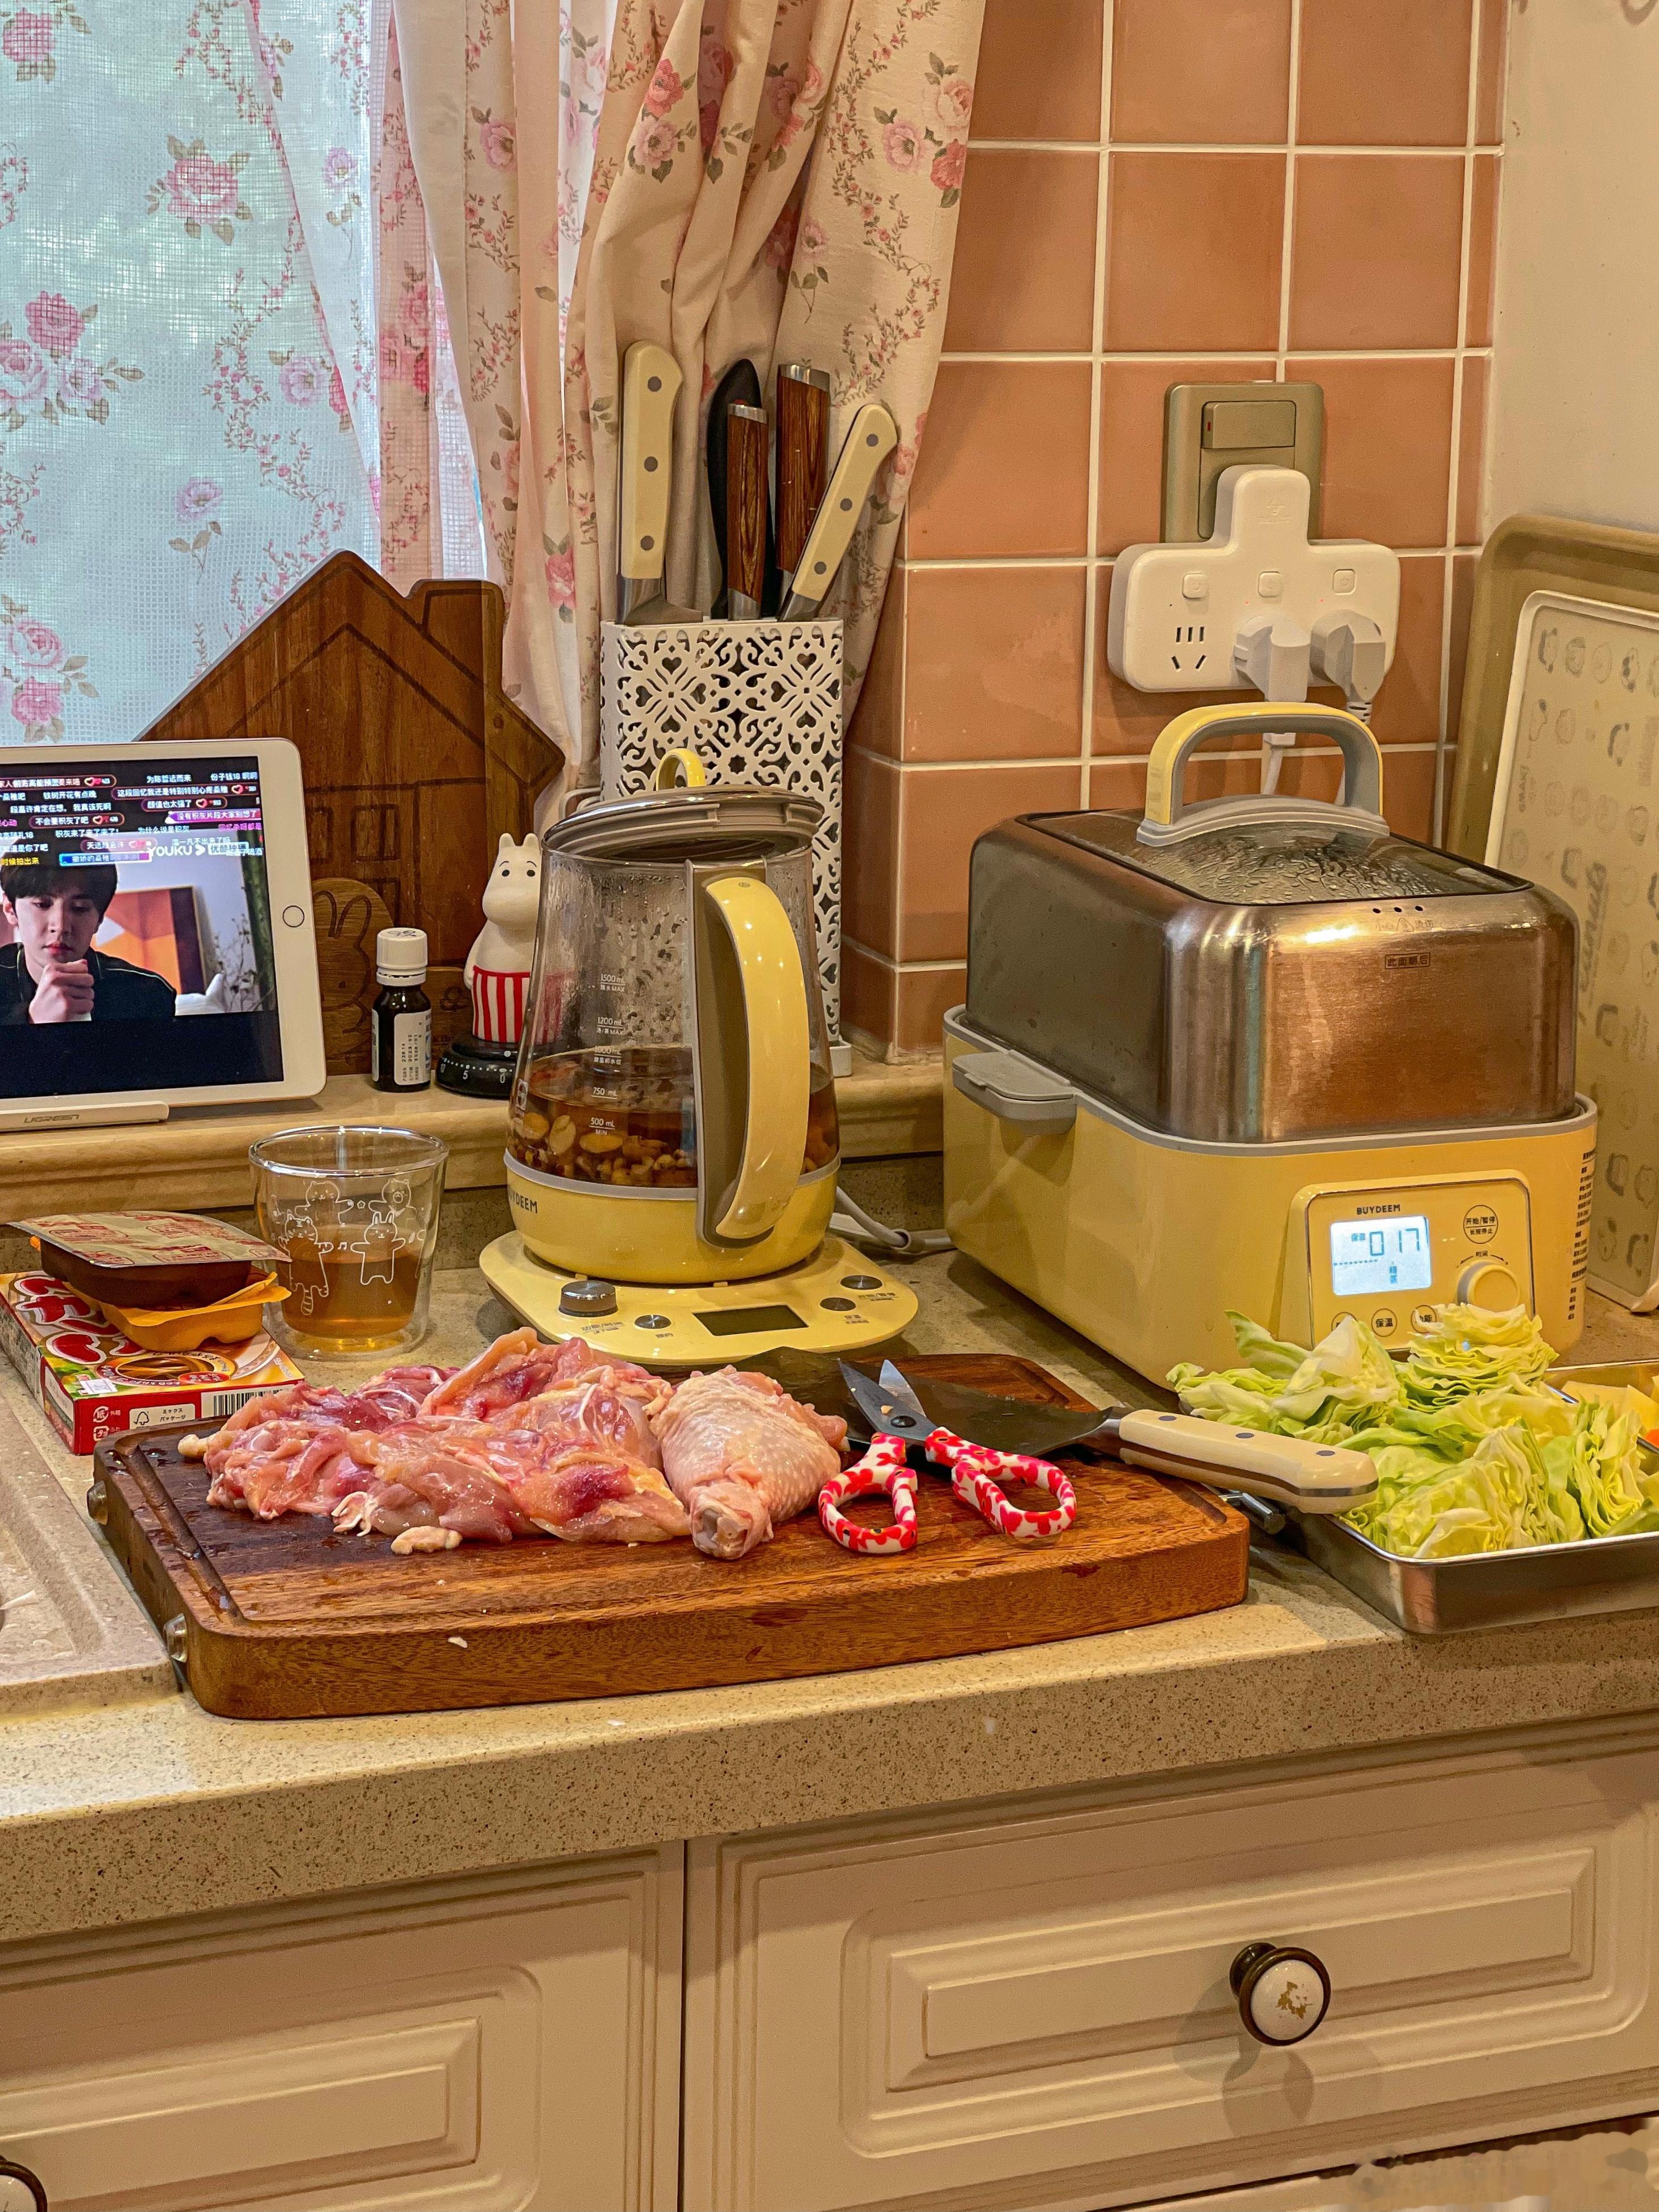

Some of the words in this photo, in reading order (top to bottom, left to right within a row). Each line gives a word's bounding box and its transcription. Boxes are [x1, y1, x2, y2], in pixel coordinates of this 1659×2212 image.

[147, 845, 192, 857] YOUKU
[600, 974, 616, 982] 1500
[598, 1016, 613, 1026] 1200
[463, 1070, 469, 1080] 5
[500, 1074, 505, 1083] 0
[593, 1086, 605, 1095] 750
[24, 1114, 80, 1123] UGREEN
[591, 1117, 604, 1126] 500
[1357, 1204, 1401, 1215] BUYDEEM
[1466, 1216, 1495, 1225] 开始/暂停
[1369, 1227, 1420, 1256] 017
[1375, 1317, 1393, 1327] 保温
